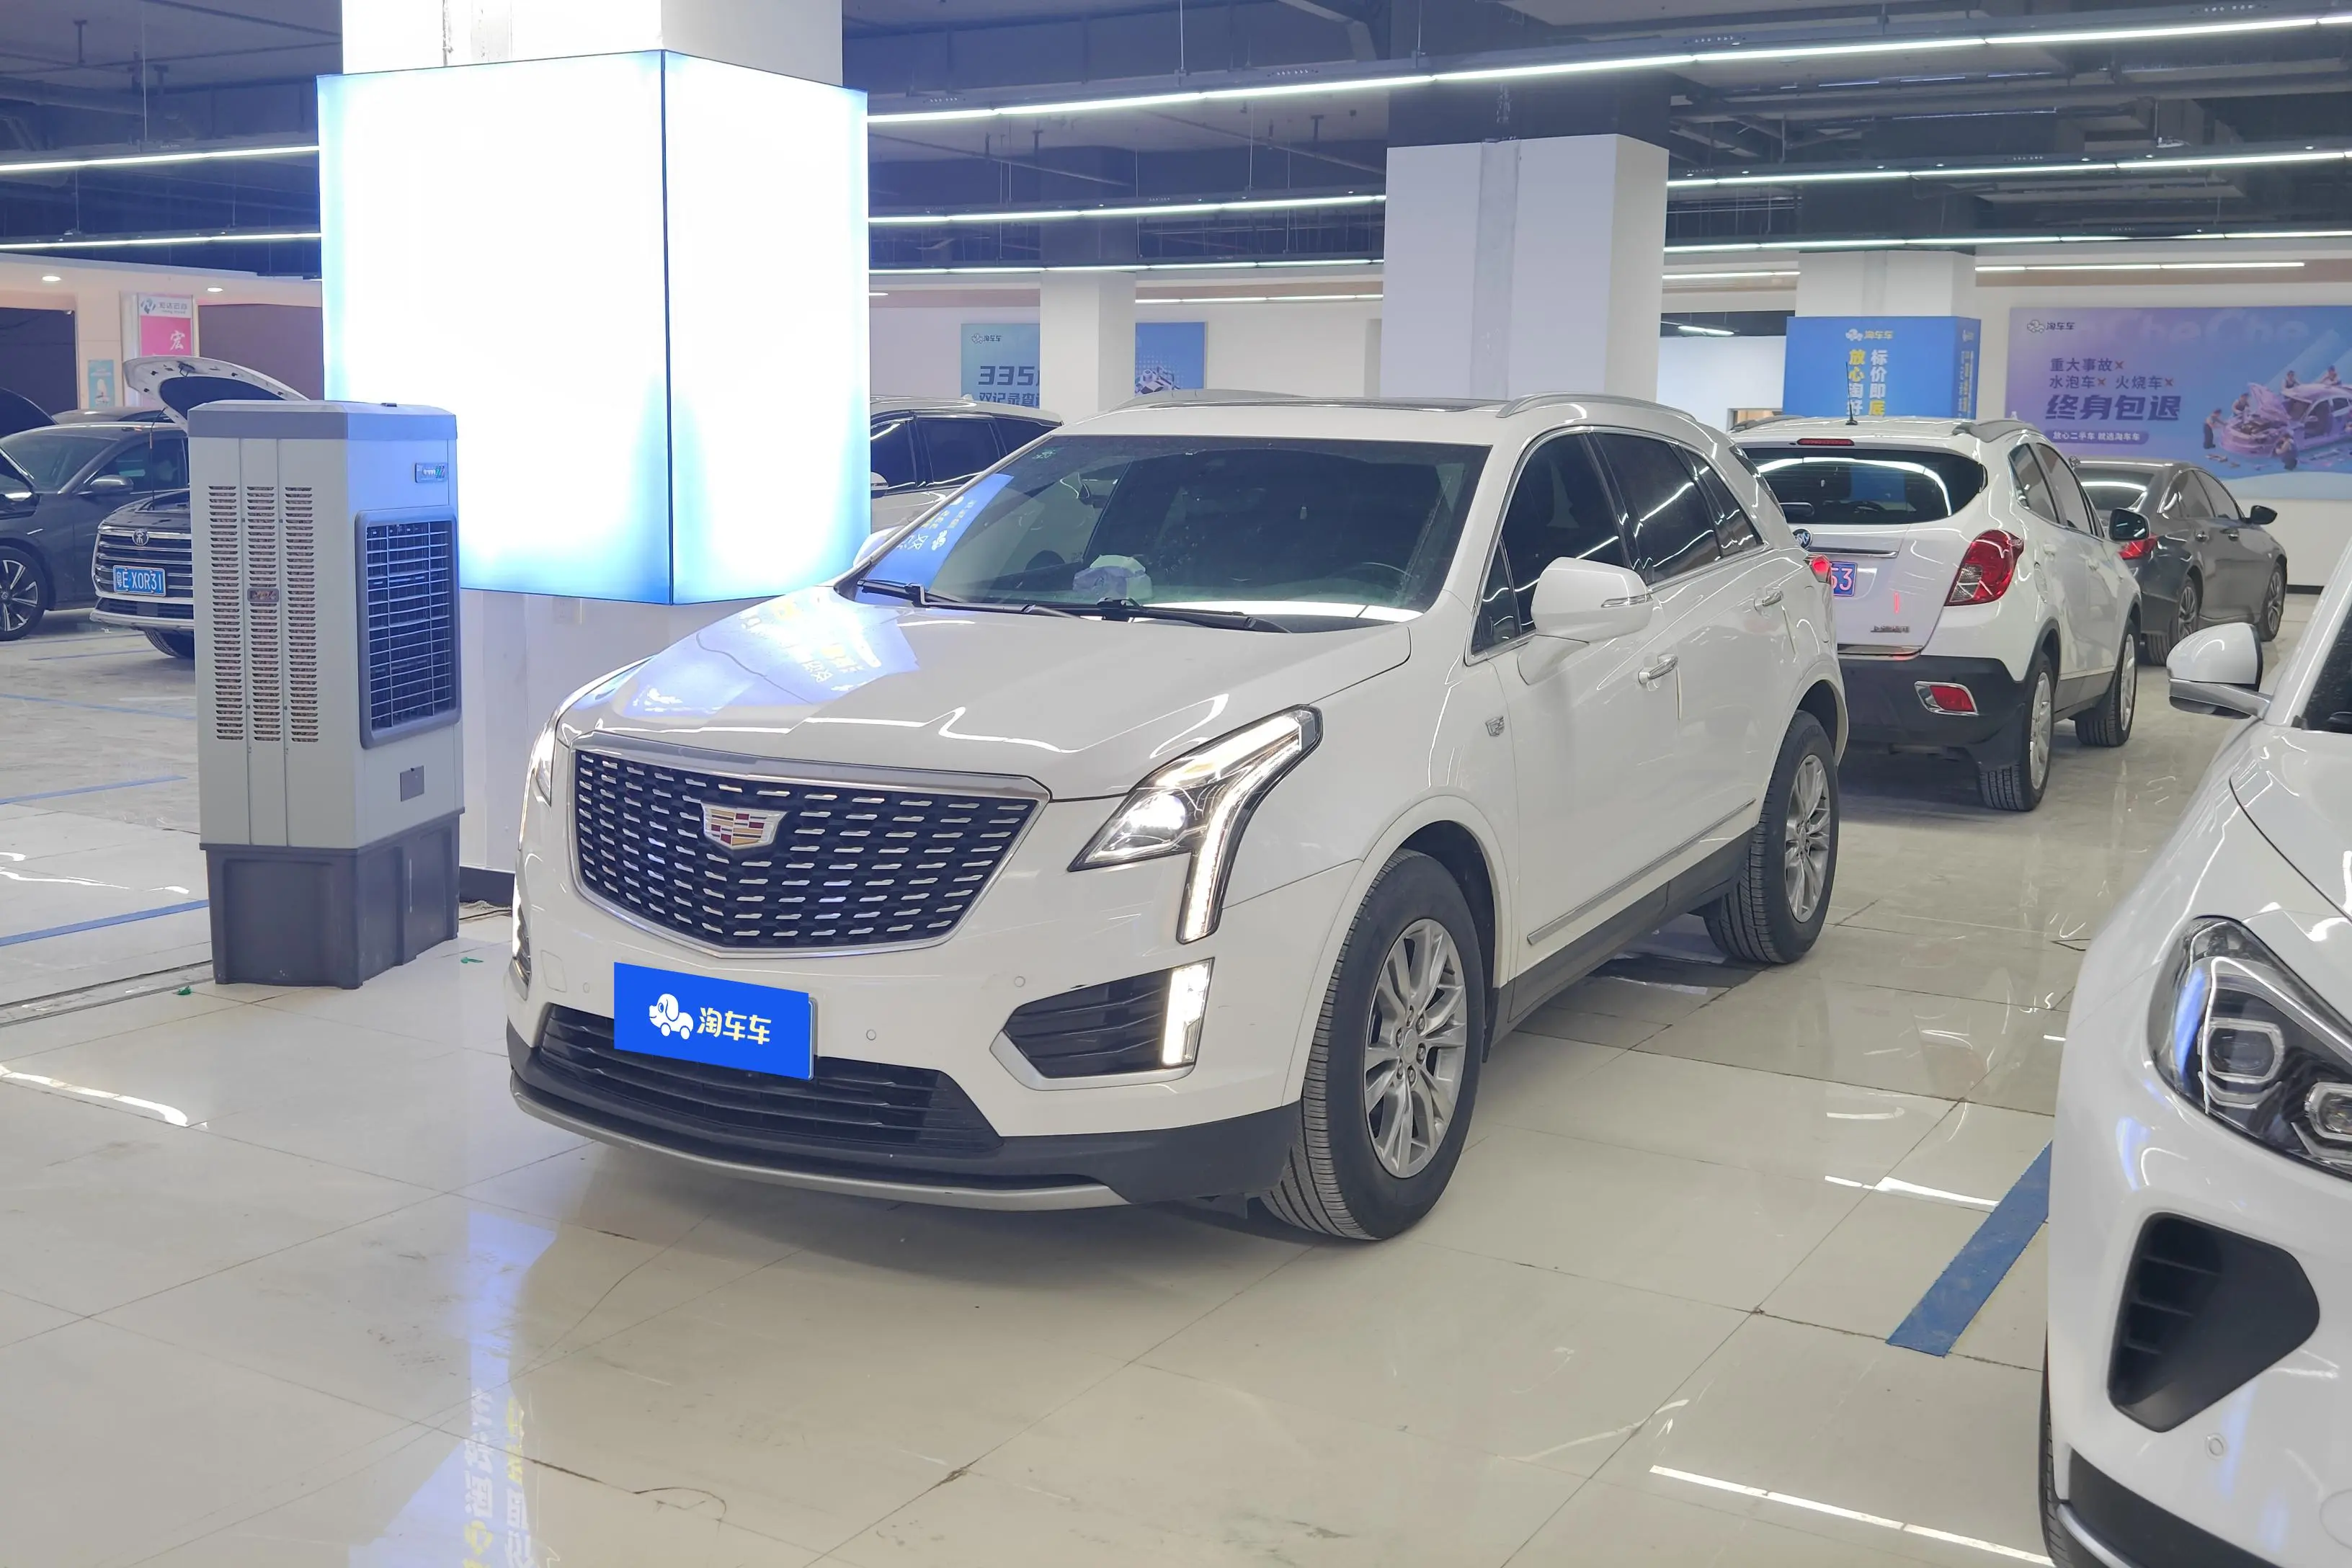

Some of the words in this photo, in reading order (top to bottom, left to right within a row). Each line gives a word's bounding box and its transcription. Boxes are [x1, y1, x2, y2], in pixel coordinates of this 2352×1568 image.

[2046, 321, 2075, 331] 淘车车
[2050, 358, 2113, 372] 重大事故
[978, 365, 1039, 386] 335
[2049, 375, 2095, 389] 水泡车
[2115, 375, 2162, 390] 火烧车
[2045, 394, 2182, 421] 终身包退
[2053, 432, 2095, 440] 放心二手车
[2098, 432, 2140, 441] 就选淘车车
